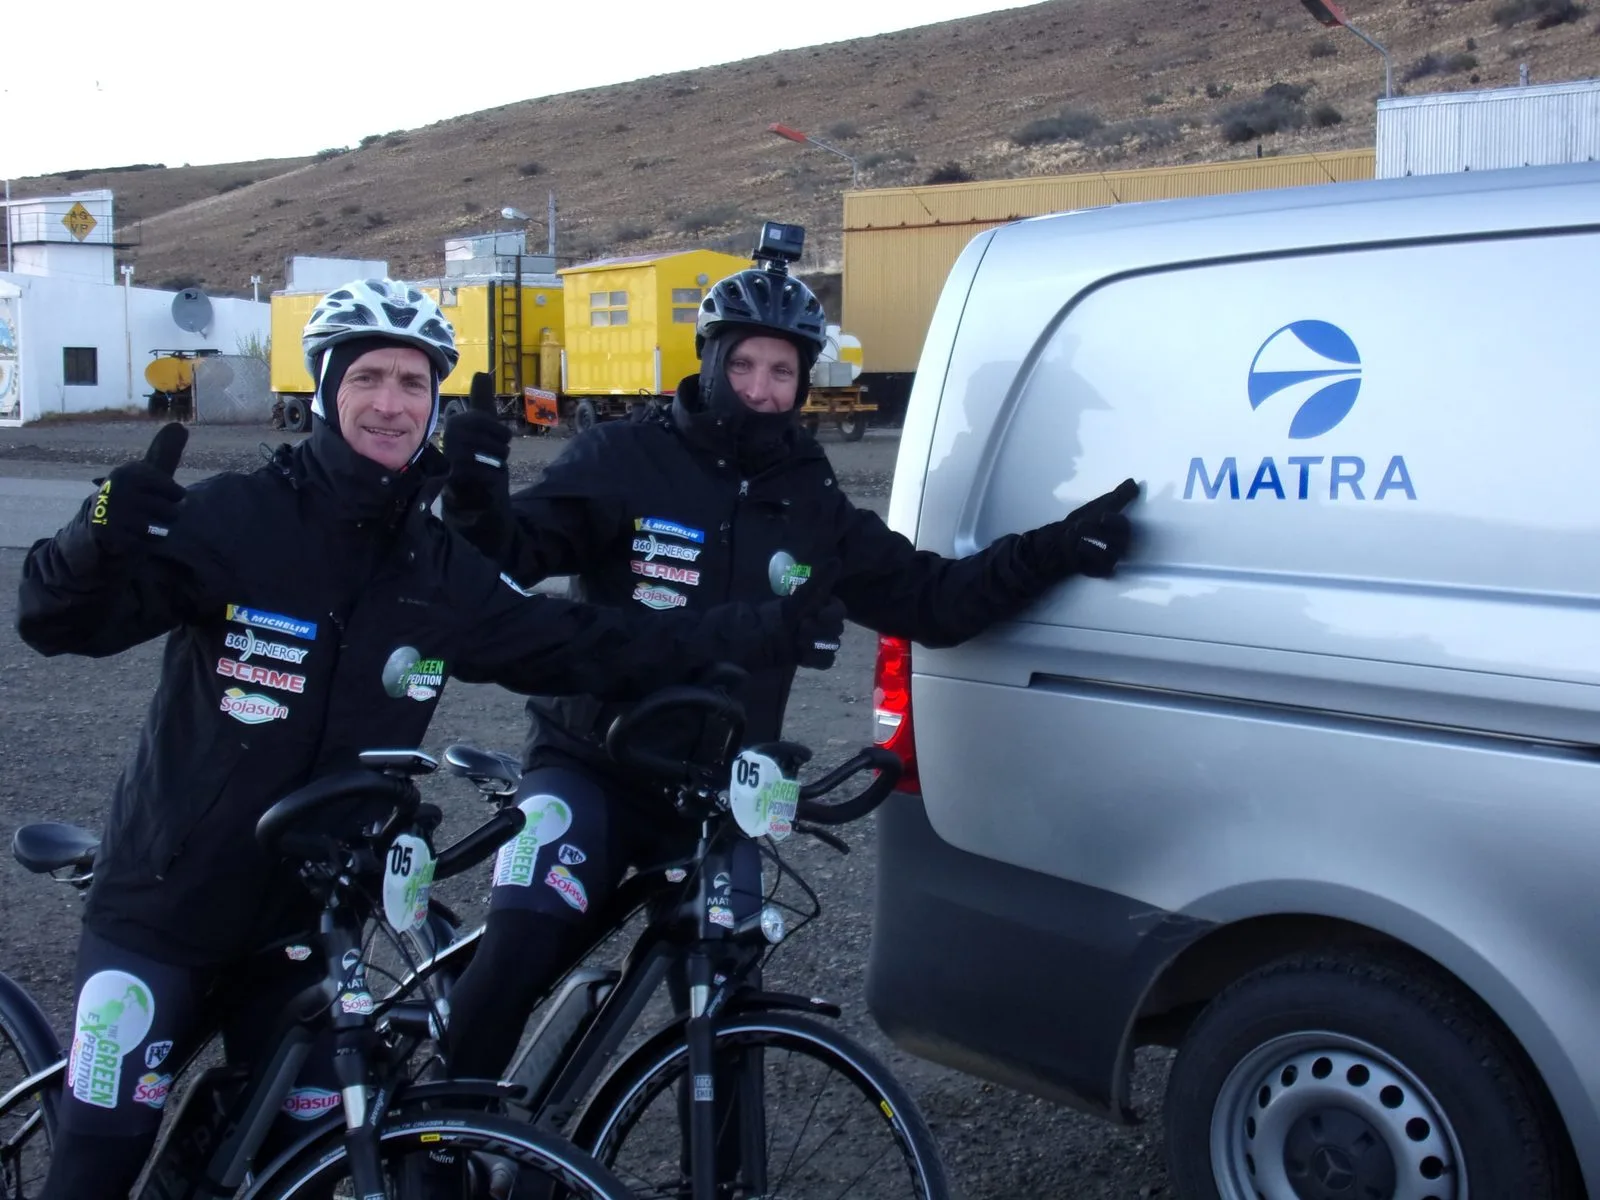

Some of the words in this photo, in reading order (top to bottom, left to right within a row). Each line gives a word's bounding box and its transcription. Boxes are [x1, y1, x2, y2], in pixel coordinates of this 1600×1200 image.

[71, 224, 88, 234] VP
[1183, 455, 1418, 500] MATRA
[651, 521, 698, 539] MICHELIN
[633, 539, 651, 552] 360
[656, 542, 700, 561] ENERGY
[631, 560, 699, 585] SCAME
[633, 587, 686, 607] Sojasun
[251, 613, 310, 635] MICHELIN
[226, 633, 249, 650] 360
[253, 641, 308, 664] ENERGY
[217, 658, 306, 693] SCAME
[221, 695, 288, 719] Sojasun
[737, 760, 760, 788] 05
[391, 844, 413, 877] 05
[511, 836, 537, 884] GREEN
[548, 872, 588, 908] Sojasun
[75, 1012, 102, 1099] EXPEDITION
[91, 1040, 120, 1105] GREEN
[284, 1092, 341, 1112] ojasun
[429, 1150, 455, 1164] Nalini
